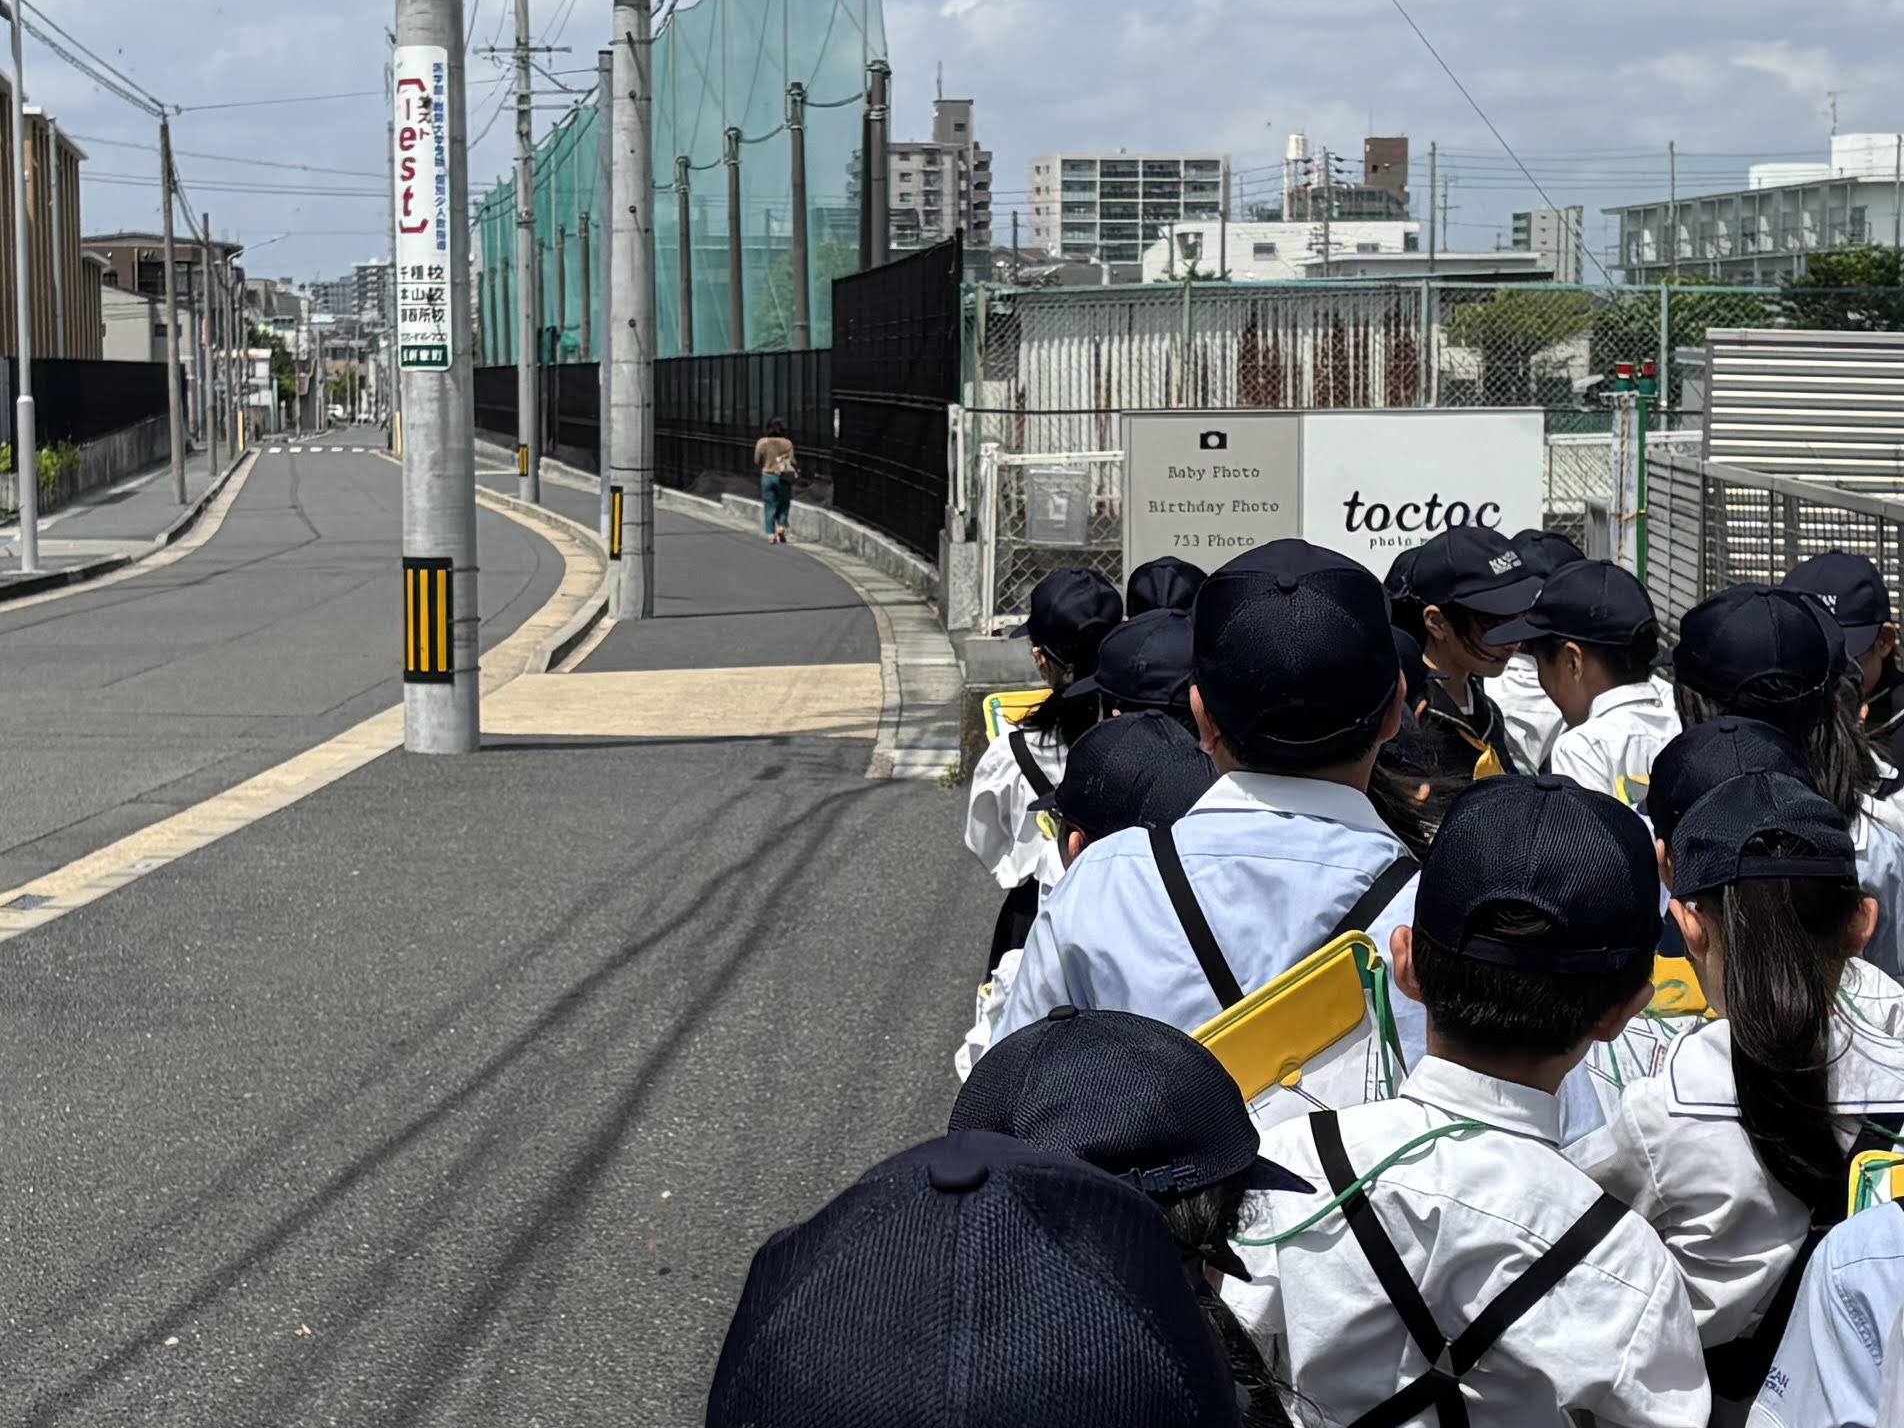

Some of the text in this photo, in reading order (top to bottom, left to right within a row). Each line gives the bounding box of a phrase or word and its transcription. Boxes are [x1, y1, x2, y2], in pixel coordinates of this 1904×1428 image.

[1168, 466, 1260, 481] Baby Photo
[1148, 499, 1279, 515] Birthday Photo
[1343, 490, 1502, 532] toctoc
[1173, 534, 1255, 547] 753 Photo
[1369, 536, 1413, 549] photo
